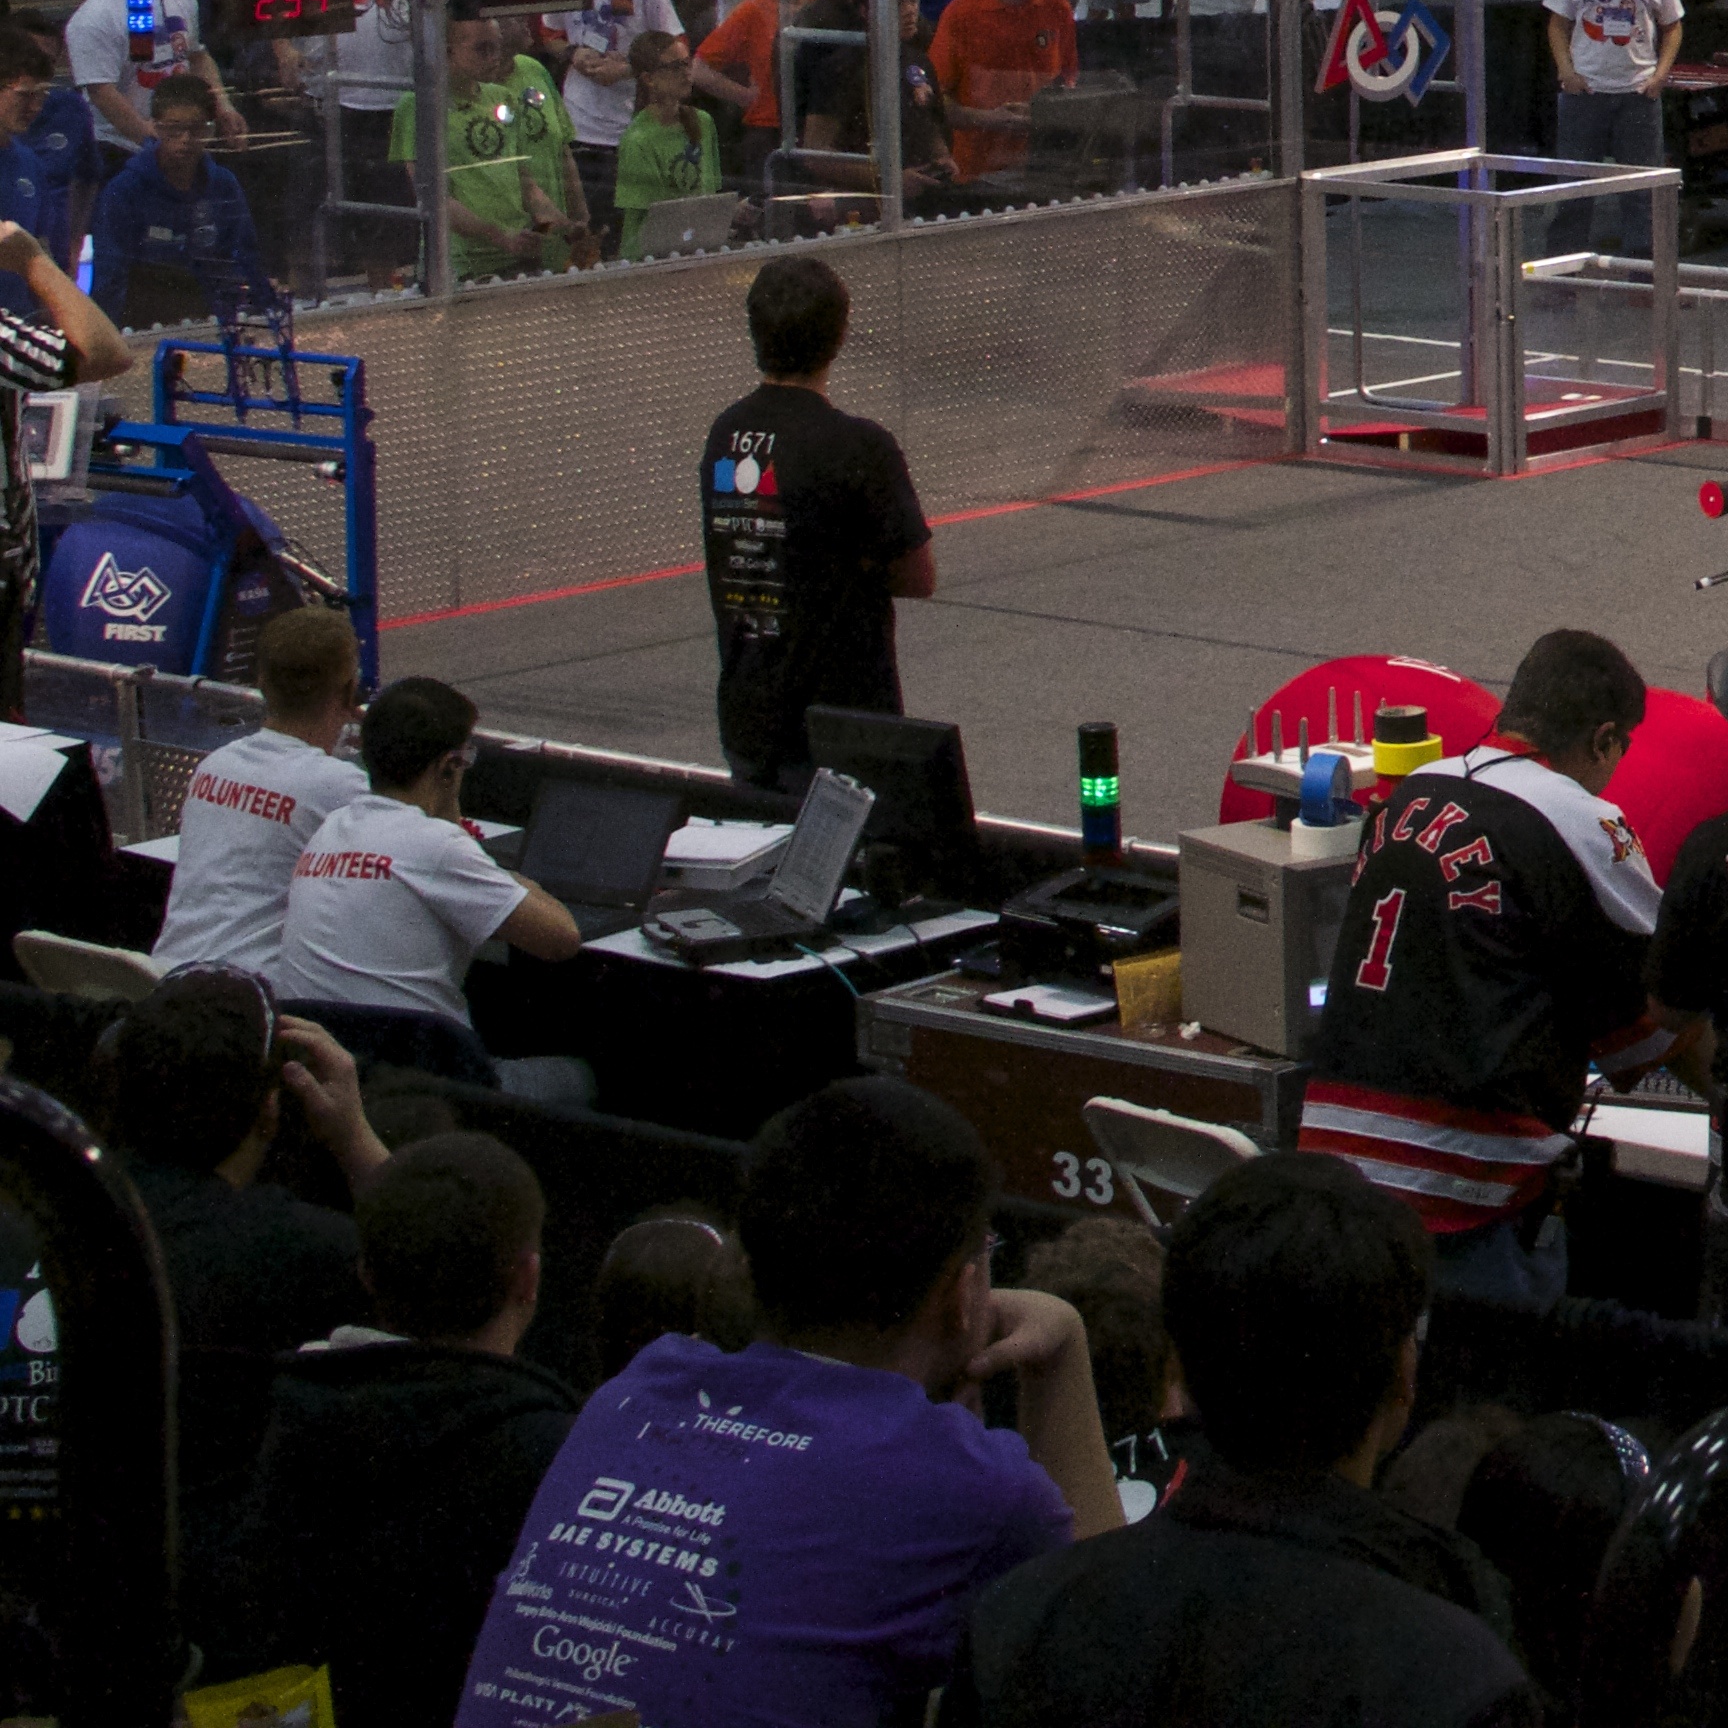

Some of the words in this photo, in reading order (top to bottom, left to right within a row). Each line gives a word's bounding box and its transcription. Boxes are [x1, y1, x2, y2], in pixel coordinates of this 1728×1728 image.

[730, 431, 776, 454] 1671
[104, 622, 168, 642] FIRST
[189, 772, 296, 826] VOLUNTEER
[293, 851, 393, 880] OLUNTEER
[1351, 797, 1502, 915] ICKEY
[1355, 887, 1408, 992] 1
[1051, 1151, 1115, 1205] 33
[693, 1413, 813, 1451] THEREFORE
[633, 1488, 726, 1526] Abbott
[548, 1522, 594, 1546] BAE
[596, 1532, 720, 1578] SYSTEMS
[559, 1561, 653, 1598] INTUITIVE
[532, 1624, 640, 1682] Google
